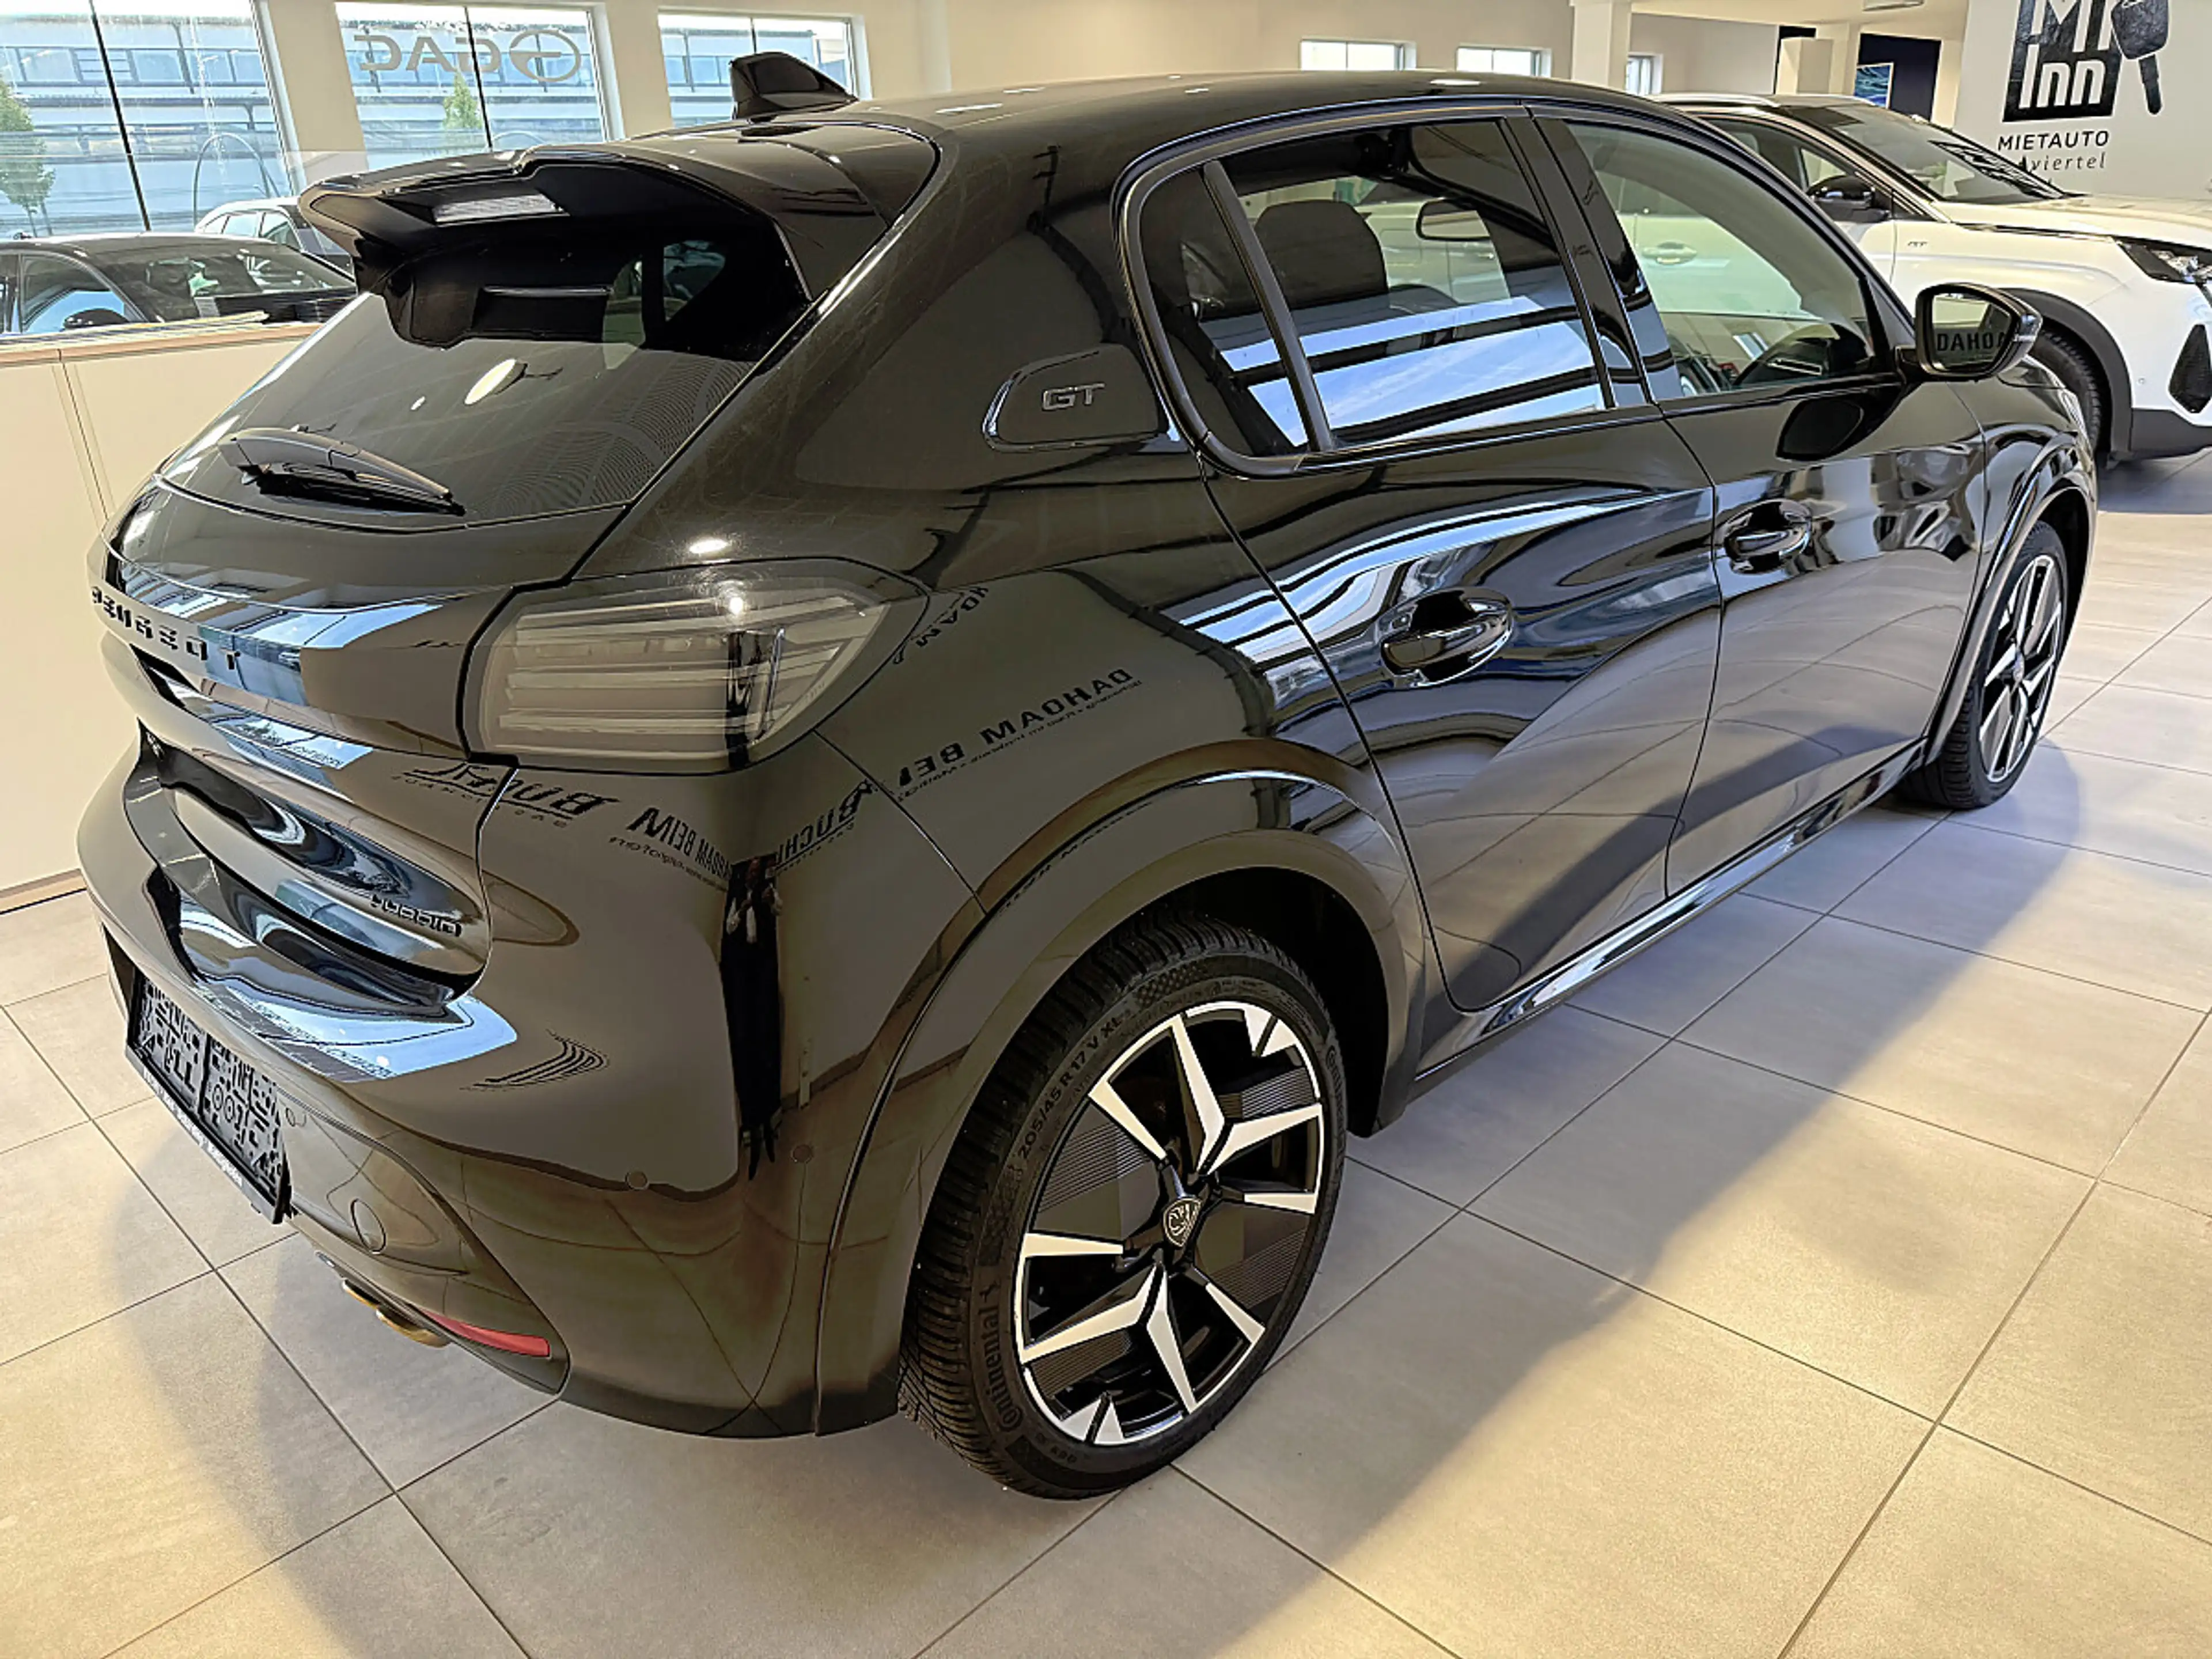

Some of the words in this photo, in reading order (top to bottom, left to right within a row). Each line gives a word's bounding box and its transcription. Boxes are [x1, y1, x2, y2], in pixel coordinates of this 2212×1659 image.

[1997, 130, 2110, 151] MIETAUTO
[1042, 383, 1105, 411] GT
[979, 1304, 1023, 1432] Continental
